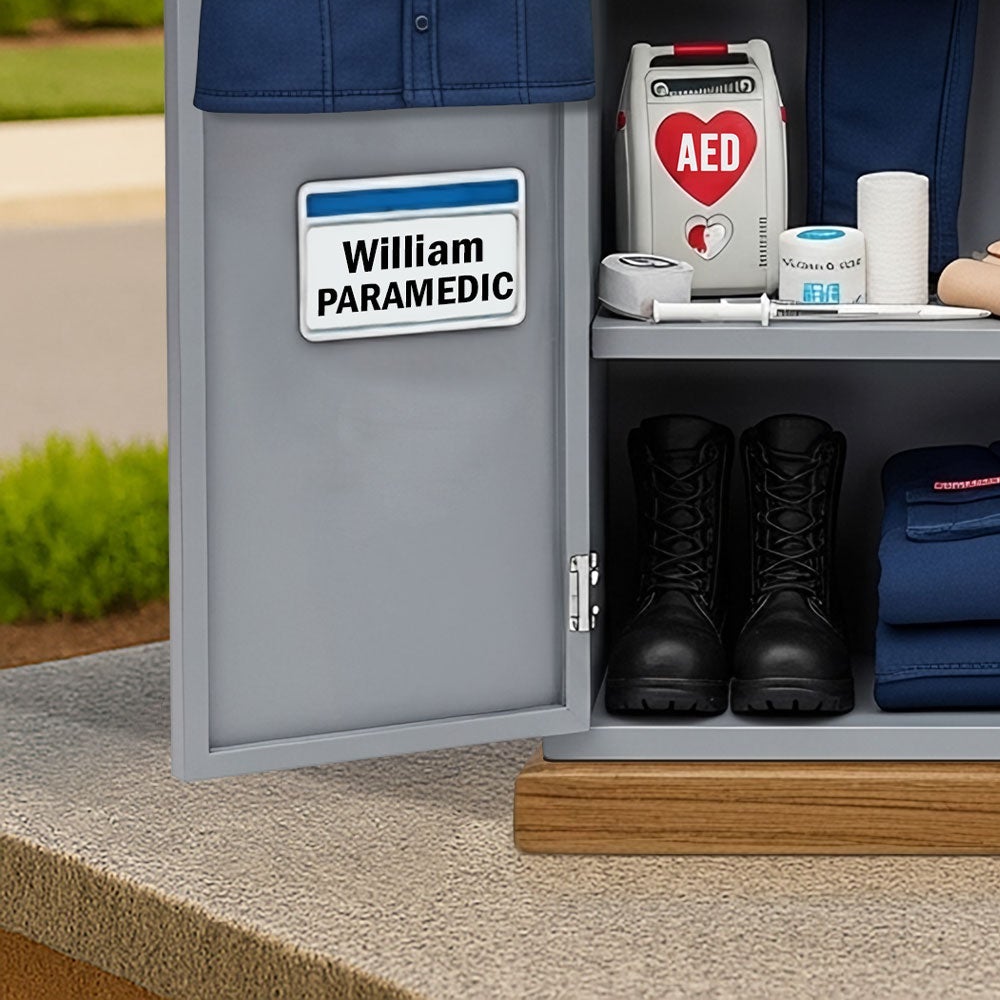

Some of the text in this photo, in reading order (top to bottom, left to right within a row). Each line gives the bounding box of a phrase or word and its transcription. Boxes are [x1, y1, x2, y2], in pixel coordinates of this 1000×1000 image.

[676, 132, 740, 172] AED
[342, 233, 484, 274] William
[317, 271, 514, 317] PARAMEDIC
